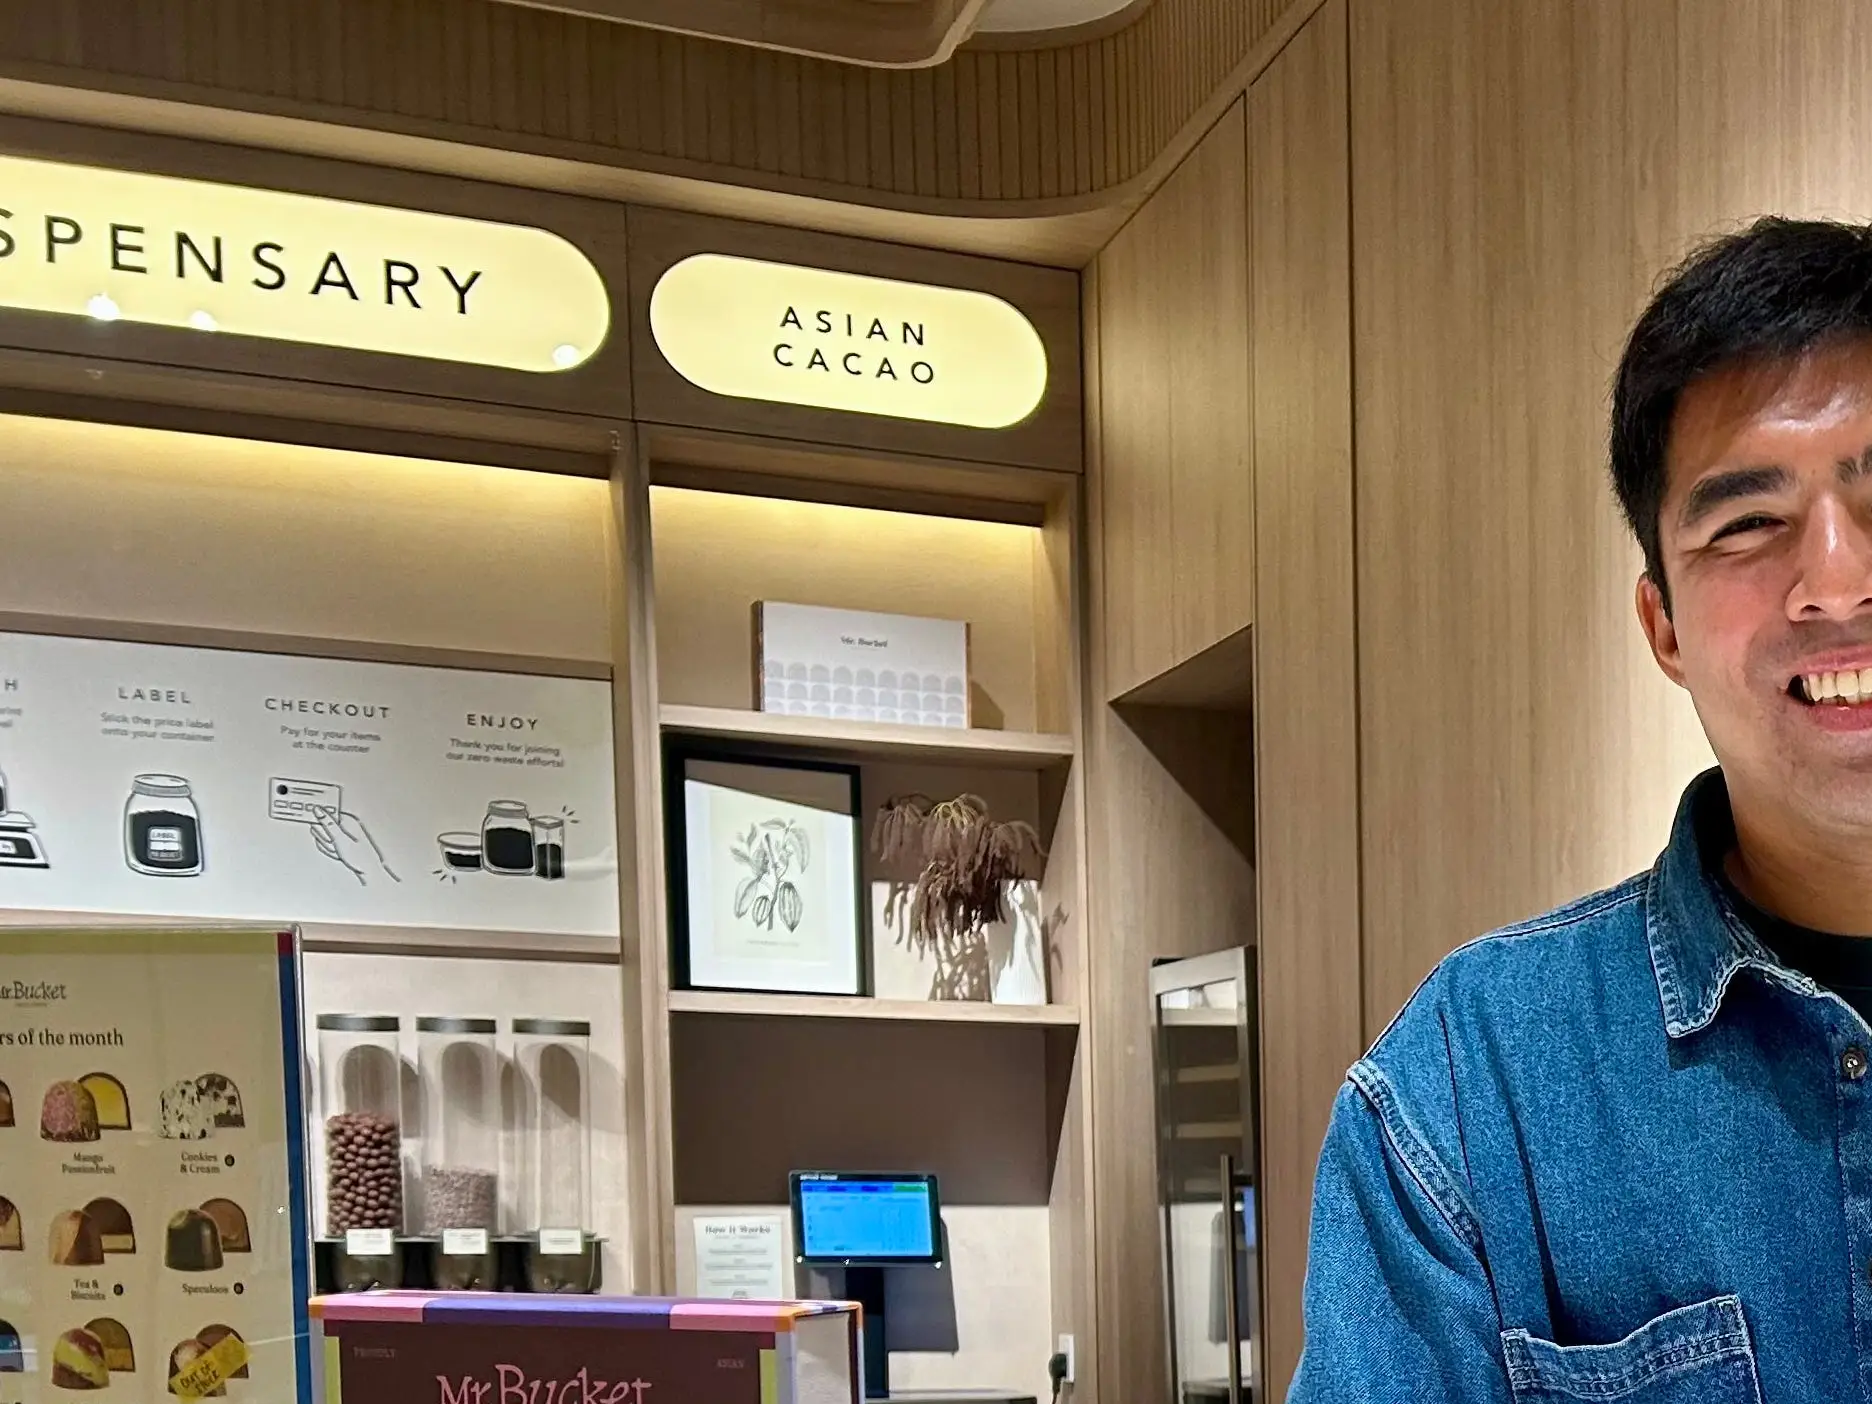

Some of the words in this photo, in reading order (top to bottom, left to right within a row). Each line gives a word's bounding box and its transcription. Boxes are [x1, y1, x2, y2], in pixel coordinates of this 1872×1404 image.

[779, 306, 925, 346] ASIAN
[773, 343, 935, 384] CACAO
[118, 686, 191, 704] LABEL
[265, 698, 391, 719] CHECKOUT
[467, 713, 538, 730] ENJOY
[450, 738, 481, 749] Thank
[18, 1027, 35, 1046] of
[39, 1027, 65, 1046] the
[69, 1027, 124, 1047] month
[73, 1152, 104, 1165] Mango
[180, 1152, 218, 1163] Cookies
[180, 1163, 188, 1174] &
[189, 1163, 221, 1175] Cream
[73, 1279, 90, 1289] Tea
[91, 1279, 99, 1289] &
